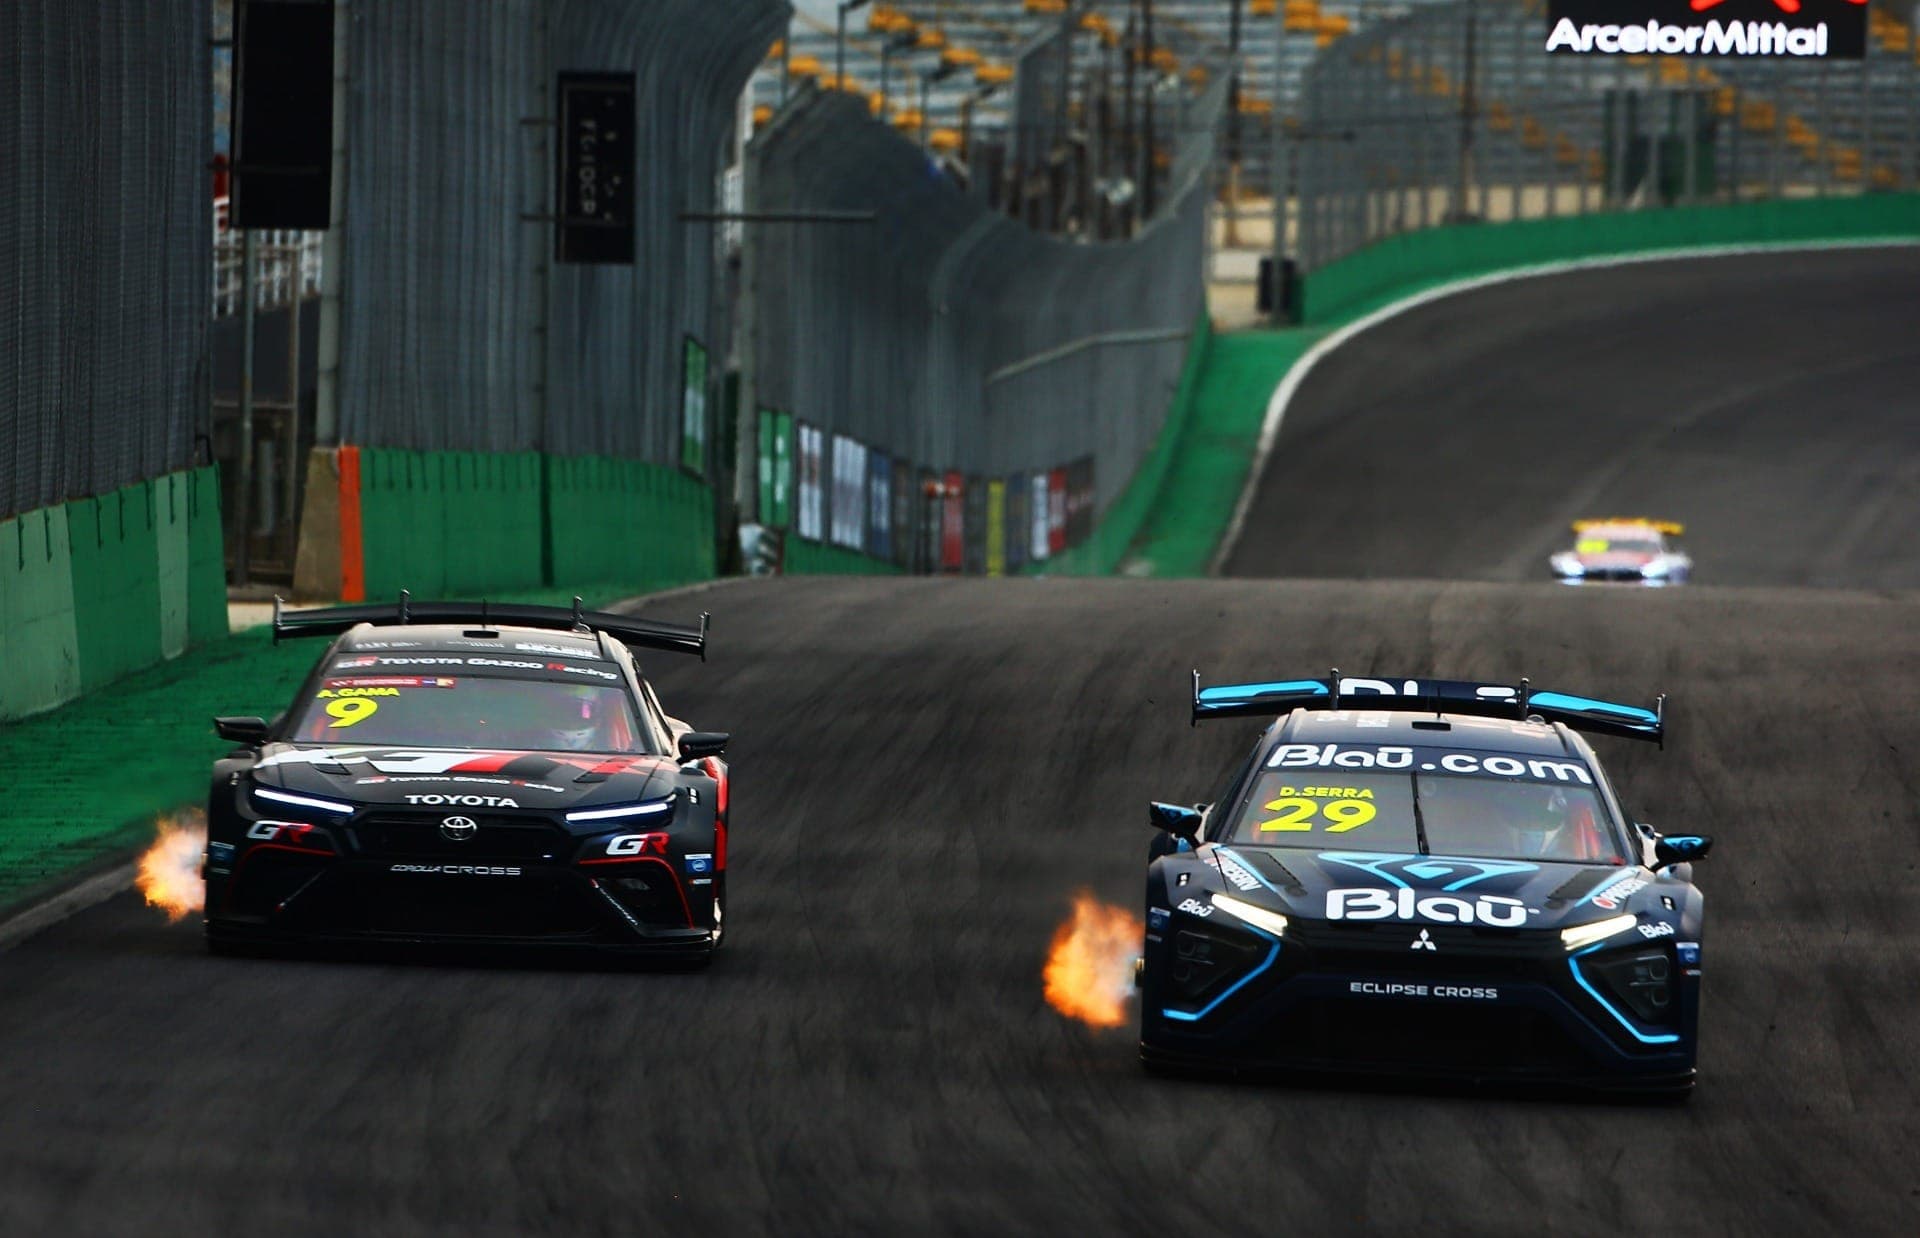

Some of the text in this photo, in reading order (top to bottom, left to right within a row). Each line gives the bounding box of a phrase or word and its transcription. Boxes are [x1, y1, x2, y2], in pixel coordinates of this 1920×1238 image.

[1546, 17, 1828, 55] ArcelorMittal
[379, 657, 463, 666] TOYOTA
[466, 657, 544, 670] GAZOO
[546, 662, 618, 680] Racing
[316, 687, 401, 699] A.GAMA
[325, 696, 379, 729] 9
[404, 794, 520, 809] TOYOTA
[1279, 786, 1374, 799] D.SERRA
[1260, 798, 1377, 833] 29
[246, 820, 316, 843] GR
[606, 831, 672, 856] GR
[443, 865, 521, 876] CROSS
[1349, 981, 1499, 1000] ECLIPSE CROSS
